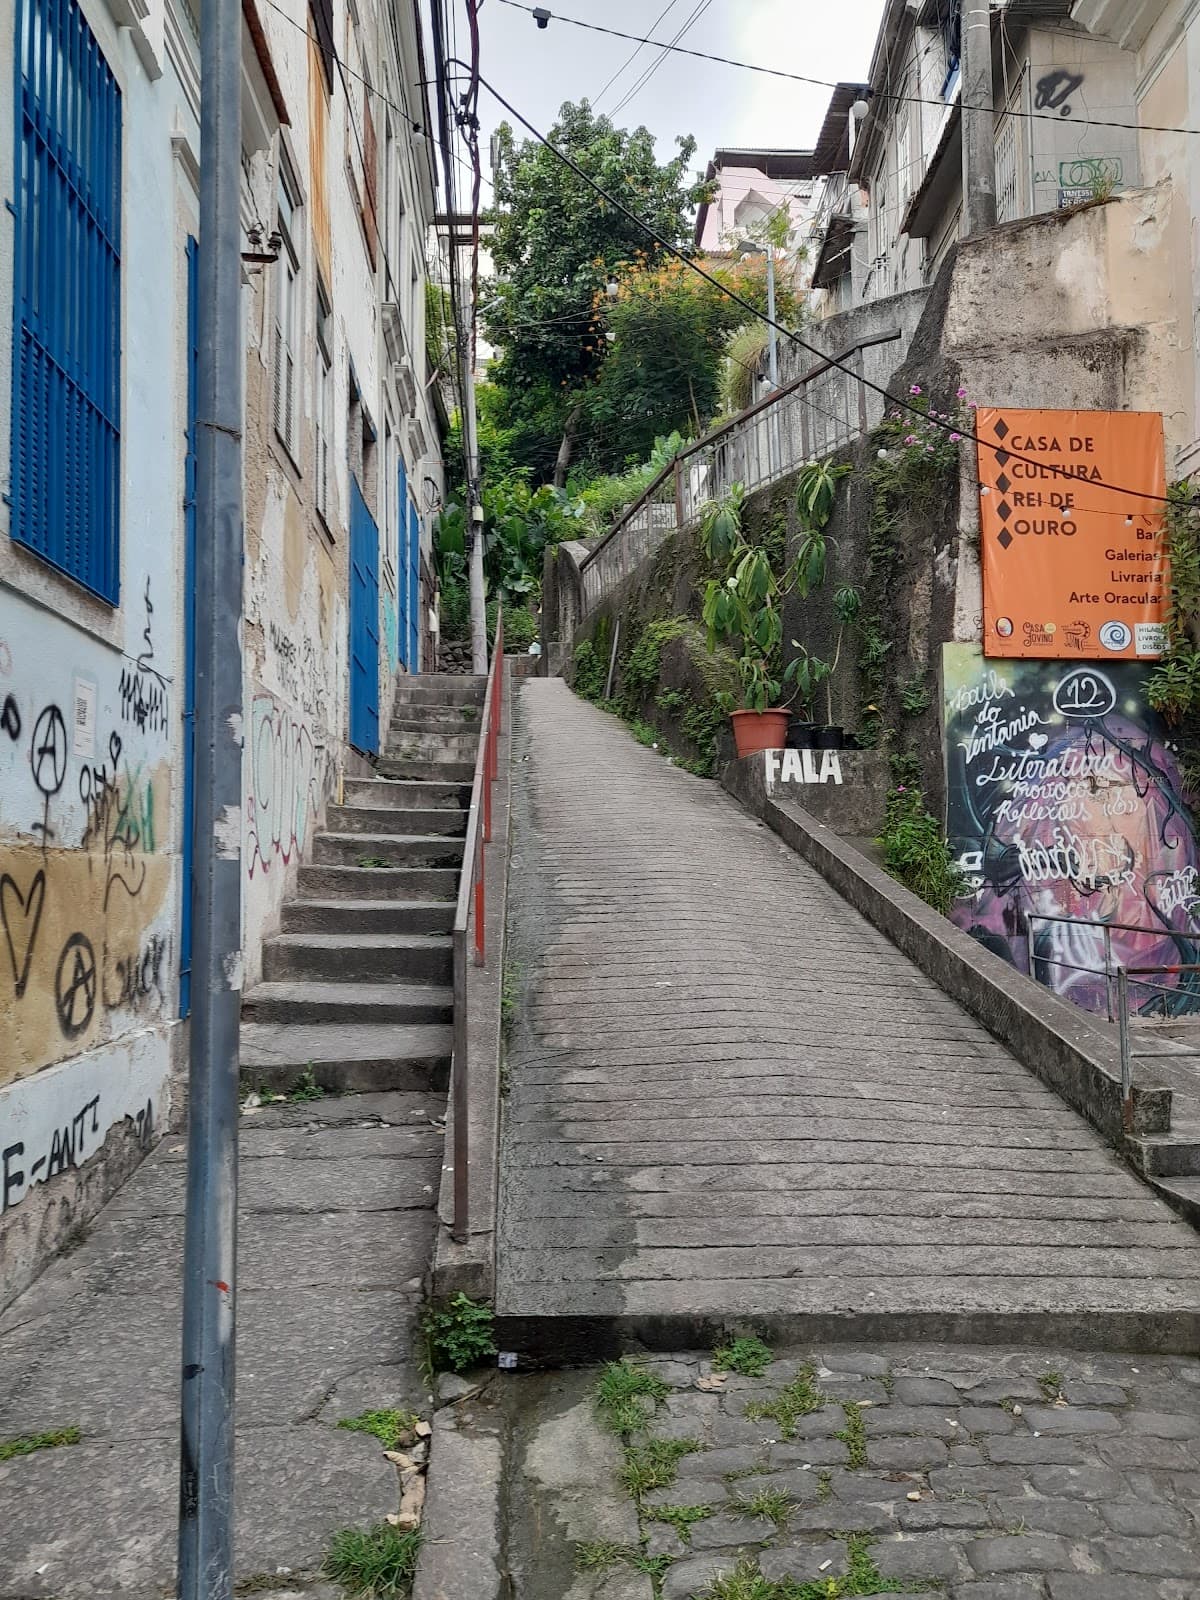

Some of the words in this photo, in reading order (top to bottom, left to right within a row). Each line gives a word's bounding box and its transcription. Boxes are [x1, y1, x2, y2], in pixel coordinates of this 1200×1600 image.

[1010, 436, 1062, 451] CASA
[1069, 437, 1095, 453] DE
[1011, 464, 1103, 481] CULTURA
[1013, 492, 1042, 507] REI
[1050, 492, 1075, 508] DE
[1014, 520, 1077, 536] OURO
[1105, 549, 1161, 561] Galerias
[1111, 570, 1161, 583] Livraria
[1069, 591, 1100, 603] Arte
[764, 748, 843, 785] FALA
[976, 749, 1130, 786] Literatura
